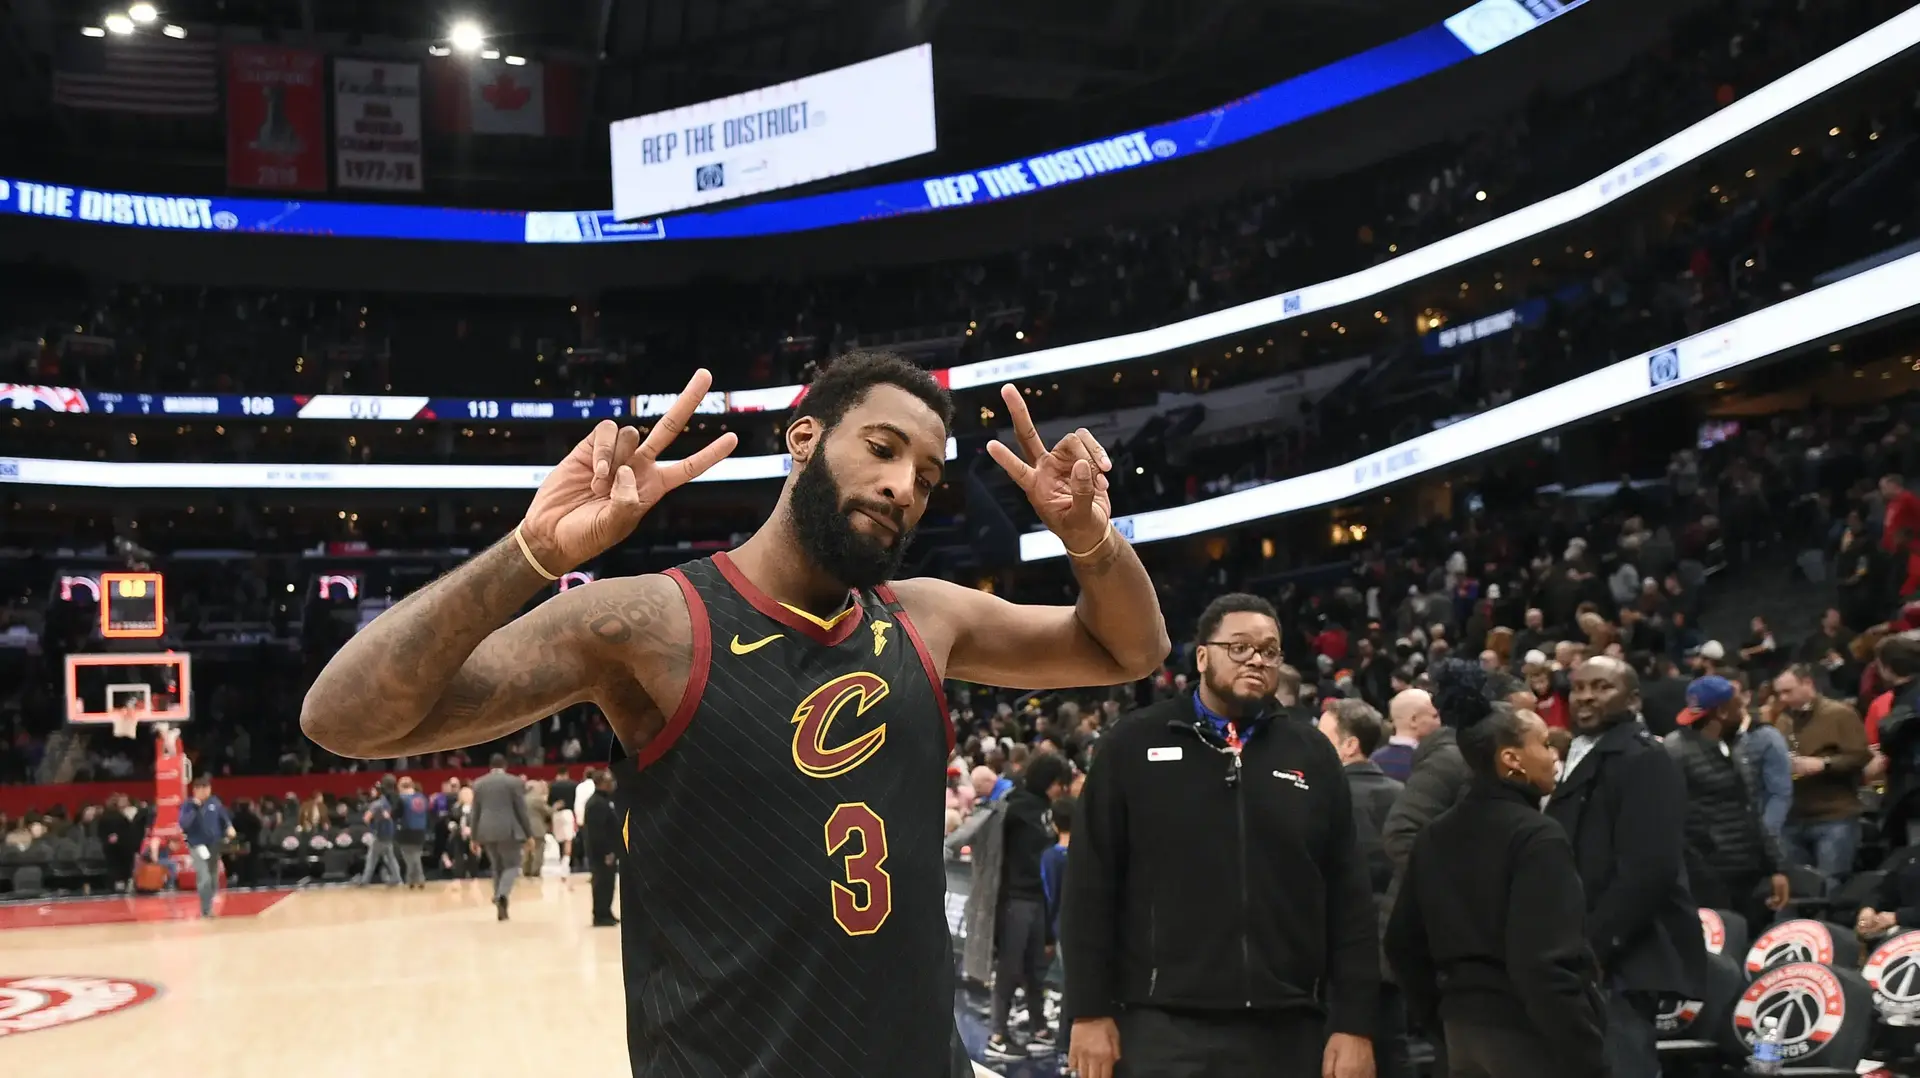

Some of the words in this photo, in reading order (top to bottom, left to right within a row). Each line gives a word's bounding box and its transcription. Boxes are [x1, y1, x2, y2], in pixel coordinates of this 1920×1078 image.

[642, 132, 678, 166] REP
[684, 123, 715, 156] THE
[723, 101, 809, 149] DISTRICT
[923, 173, 980, 208] REP
[977, 162, 1037, 199] THE
[1028, 130, 1155, 188] DISTRICT
[14, 181, 75, 218] THE
[78, 189, 213, 230] DISTRICT
[349, 398, 382, 419] 0.0
[467, 400, 500, 418] 113
[791, 671, 890, 779] C
[824, 802, 892, 937] 3
